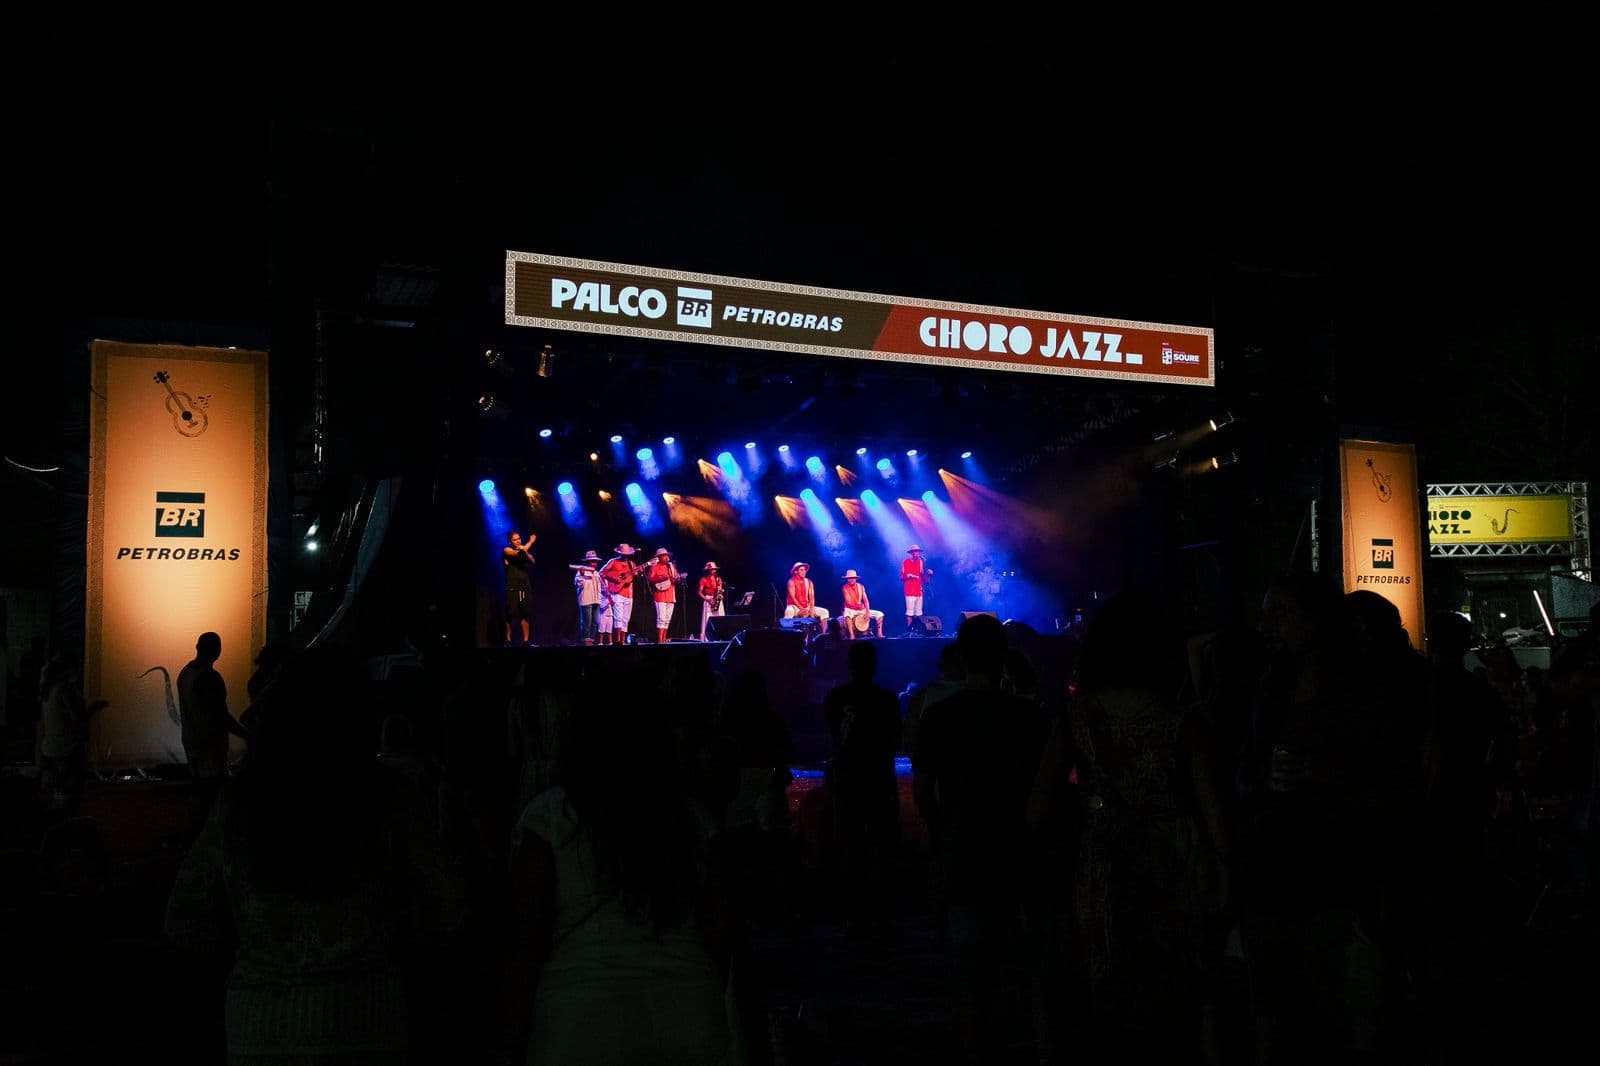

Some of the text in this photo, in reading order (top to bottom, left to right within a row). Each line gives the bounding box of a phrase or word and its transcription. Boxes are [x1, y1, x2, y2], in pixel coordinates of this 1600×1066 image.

[551, 278, 844, 332] PALCO BR PETROBRAS
[919, 316, 1033, 355] CHORO
[1173, 353, 1200, 363] SOURE
[159, 508, 201, 527] BR
[117, 547, 241, 561] PETROBRAS
[1374, 549, 1393, 562] BR
[1356, 575, 1412, 585] PETROBRAS
